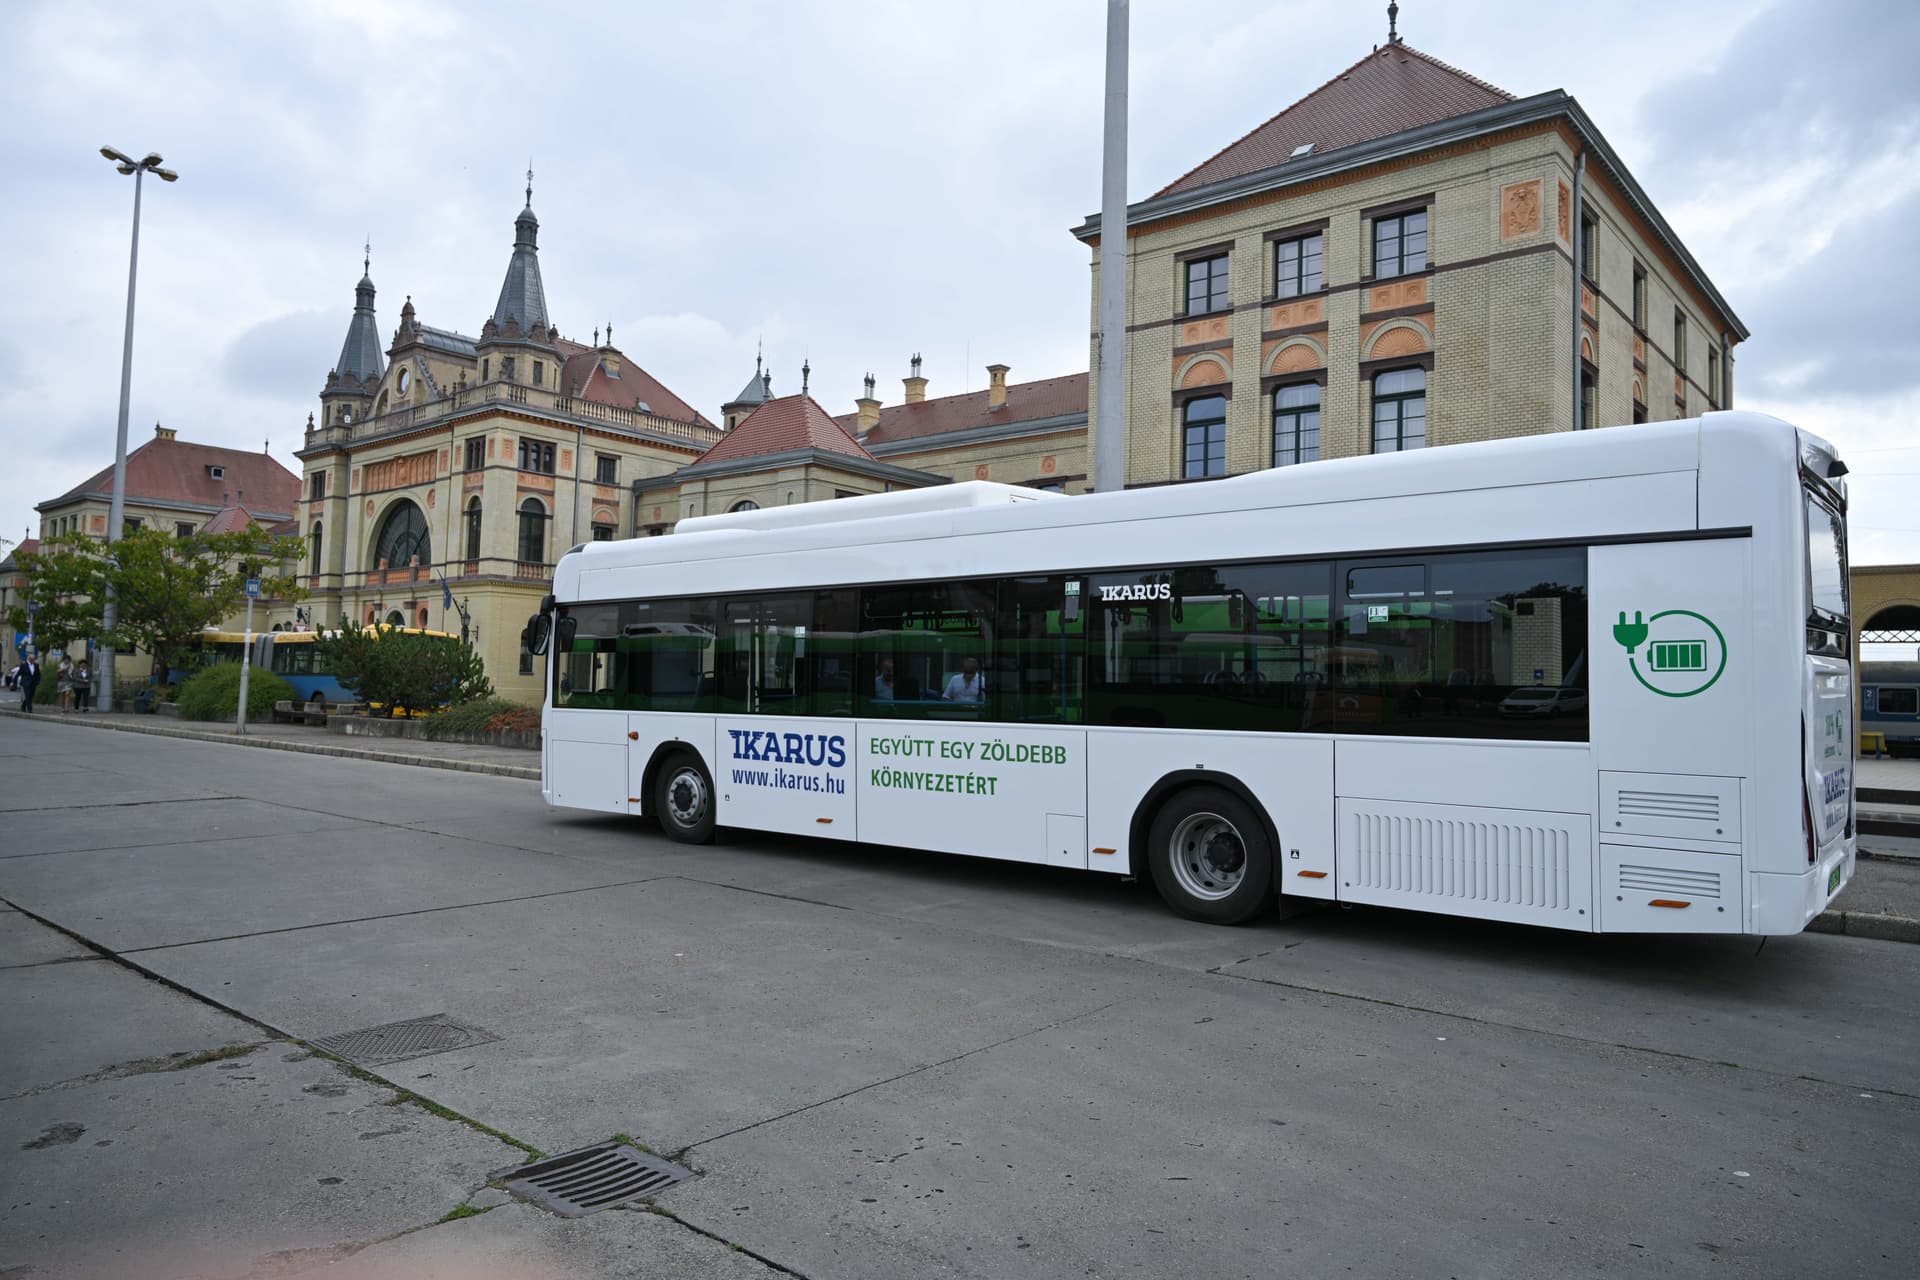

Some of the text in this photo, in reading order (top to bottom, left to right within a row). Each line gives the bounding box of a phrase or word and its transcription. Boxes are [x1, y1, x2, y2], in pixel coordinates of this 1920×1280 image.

[1099, 583, 1171, 601] IKARUS
[728, 729, 846, 768] IKARUS
[870, 735, 1067, 765] EGYÜTT EGY ZÖLDEBB
[732, 768, 845, 794] www.ikarus.hu
[871, 766, 998, 796] KÖRNYEZETÉRT
